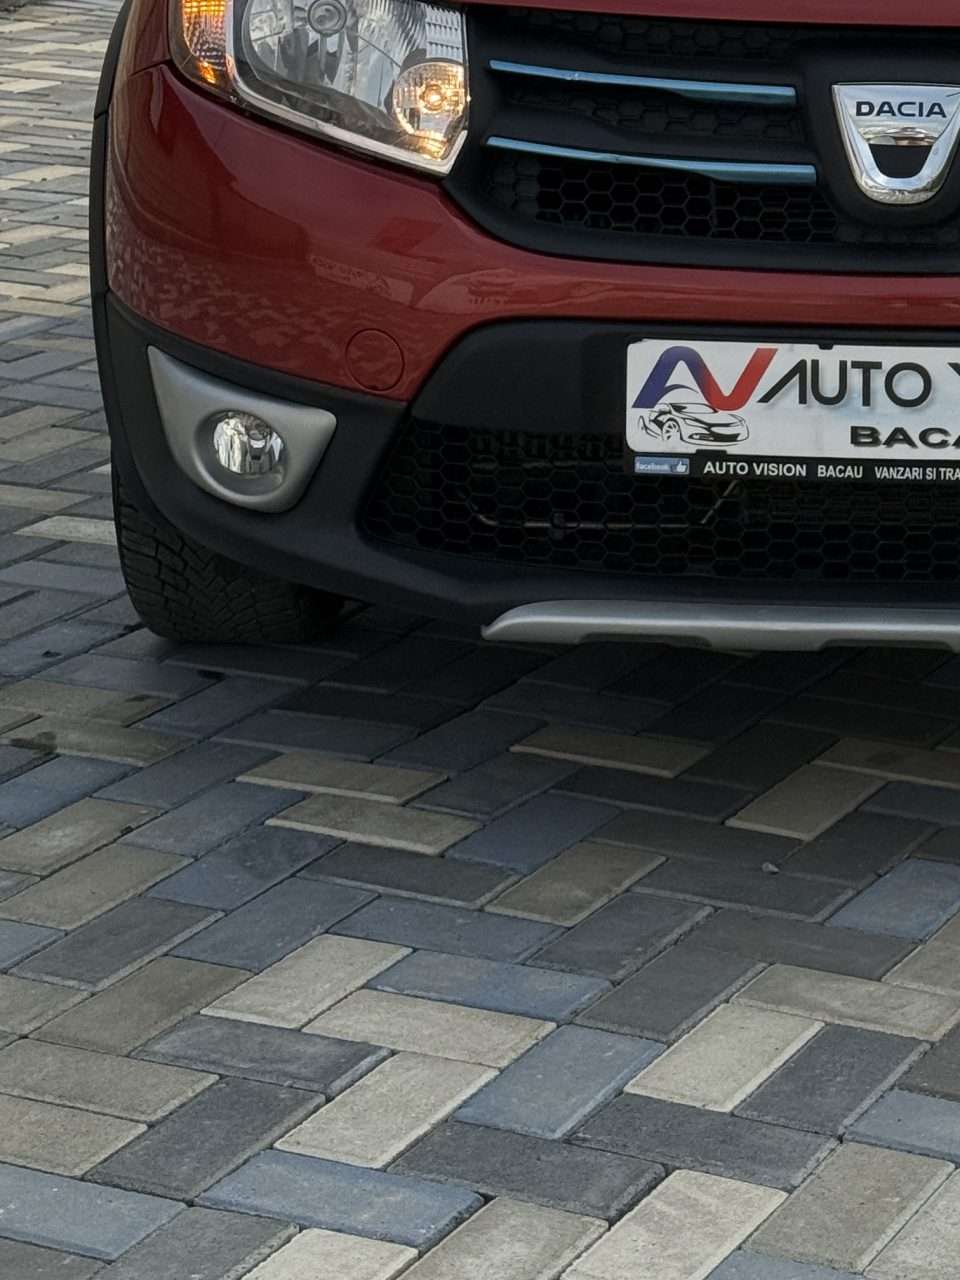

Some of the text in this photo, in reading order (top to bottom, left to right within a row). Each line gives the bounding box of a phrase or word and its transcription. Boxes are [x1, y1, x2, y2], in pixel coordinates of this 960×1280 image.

[856, 101, 947, 118] DACIA
[756, 359, 932, 407] AUTO
[703, 461, 749, 475] AUTO
[753, 463, 807, 477] VISION
[817, 465, 863, 478] BACAU
[875, 466, 923, 480] VANZARI
[926, 468, 936, 480] SI
